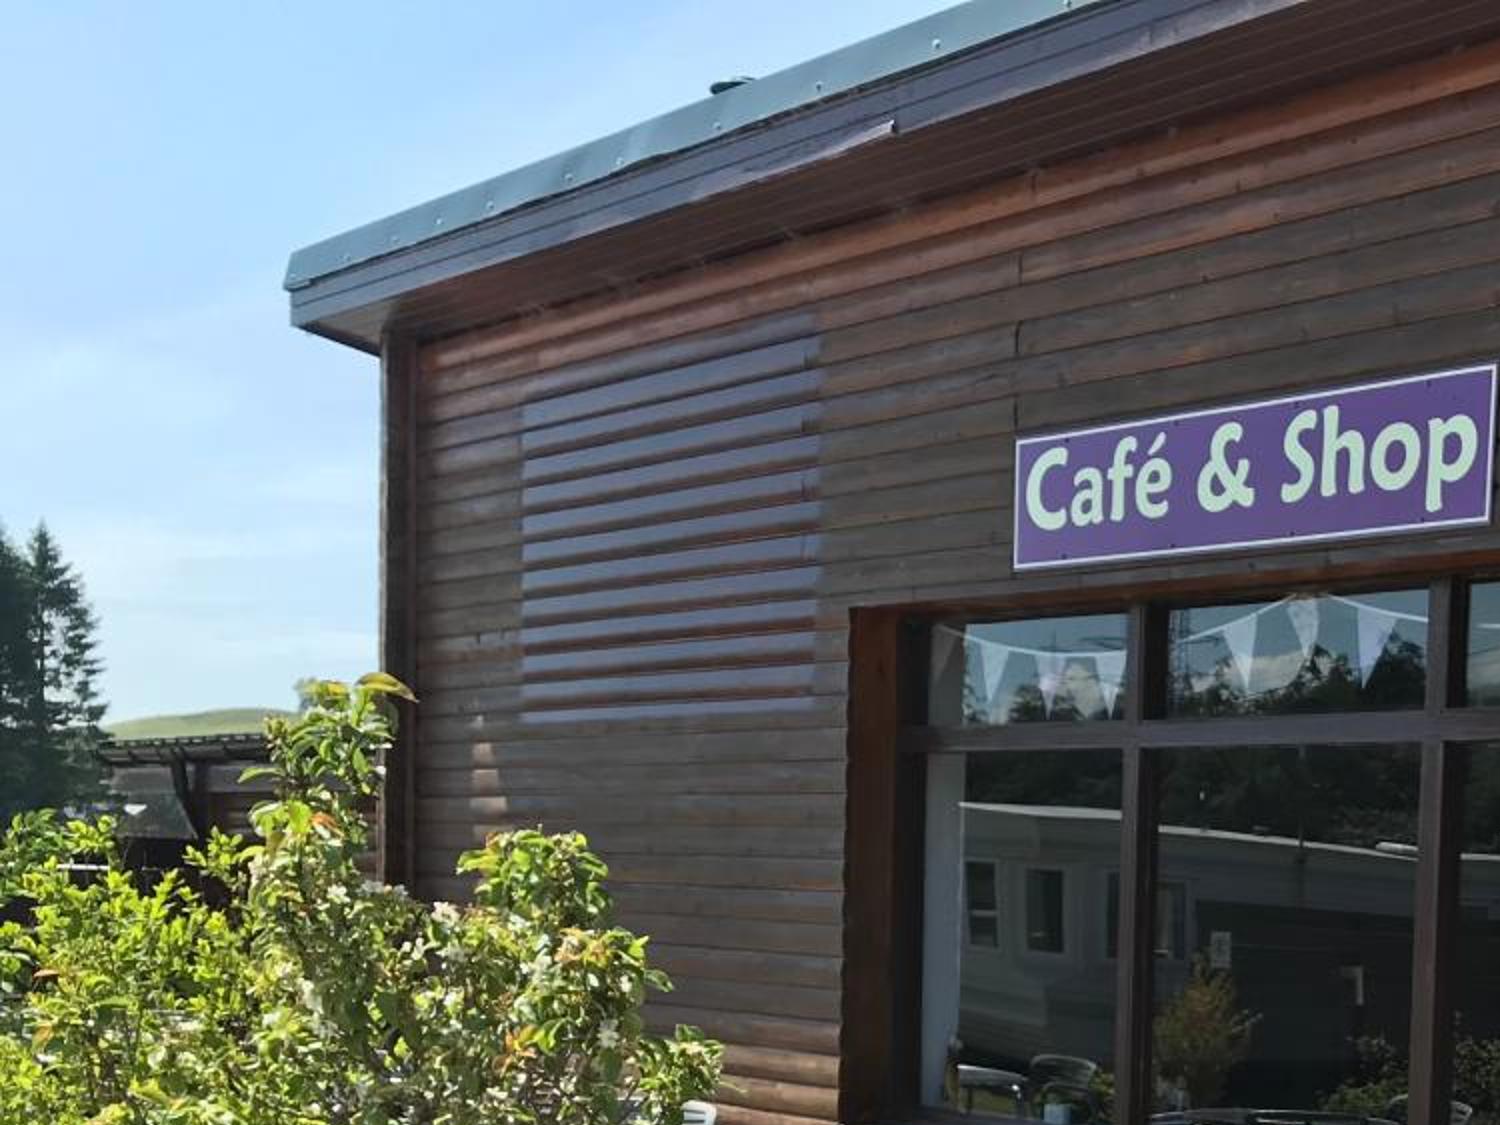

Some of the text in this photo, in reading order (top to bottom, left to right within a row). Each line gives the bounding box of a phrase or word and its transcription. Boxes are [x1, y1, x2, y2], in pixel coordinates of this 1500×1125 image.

[1025, 405, 1479, 530] Café & Shop
